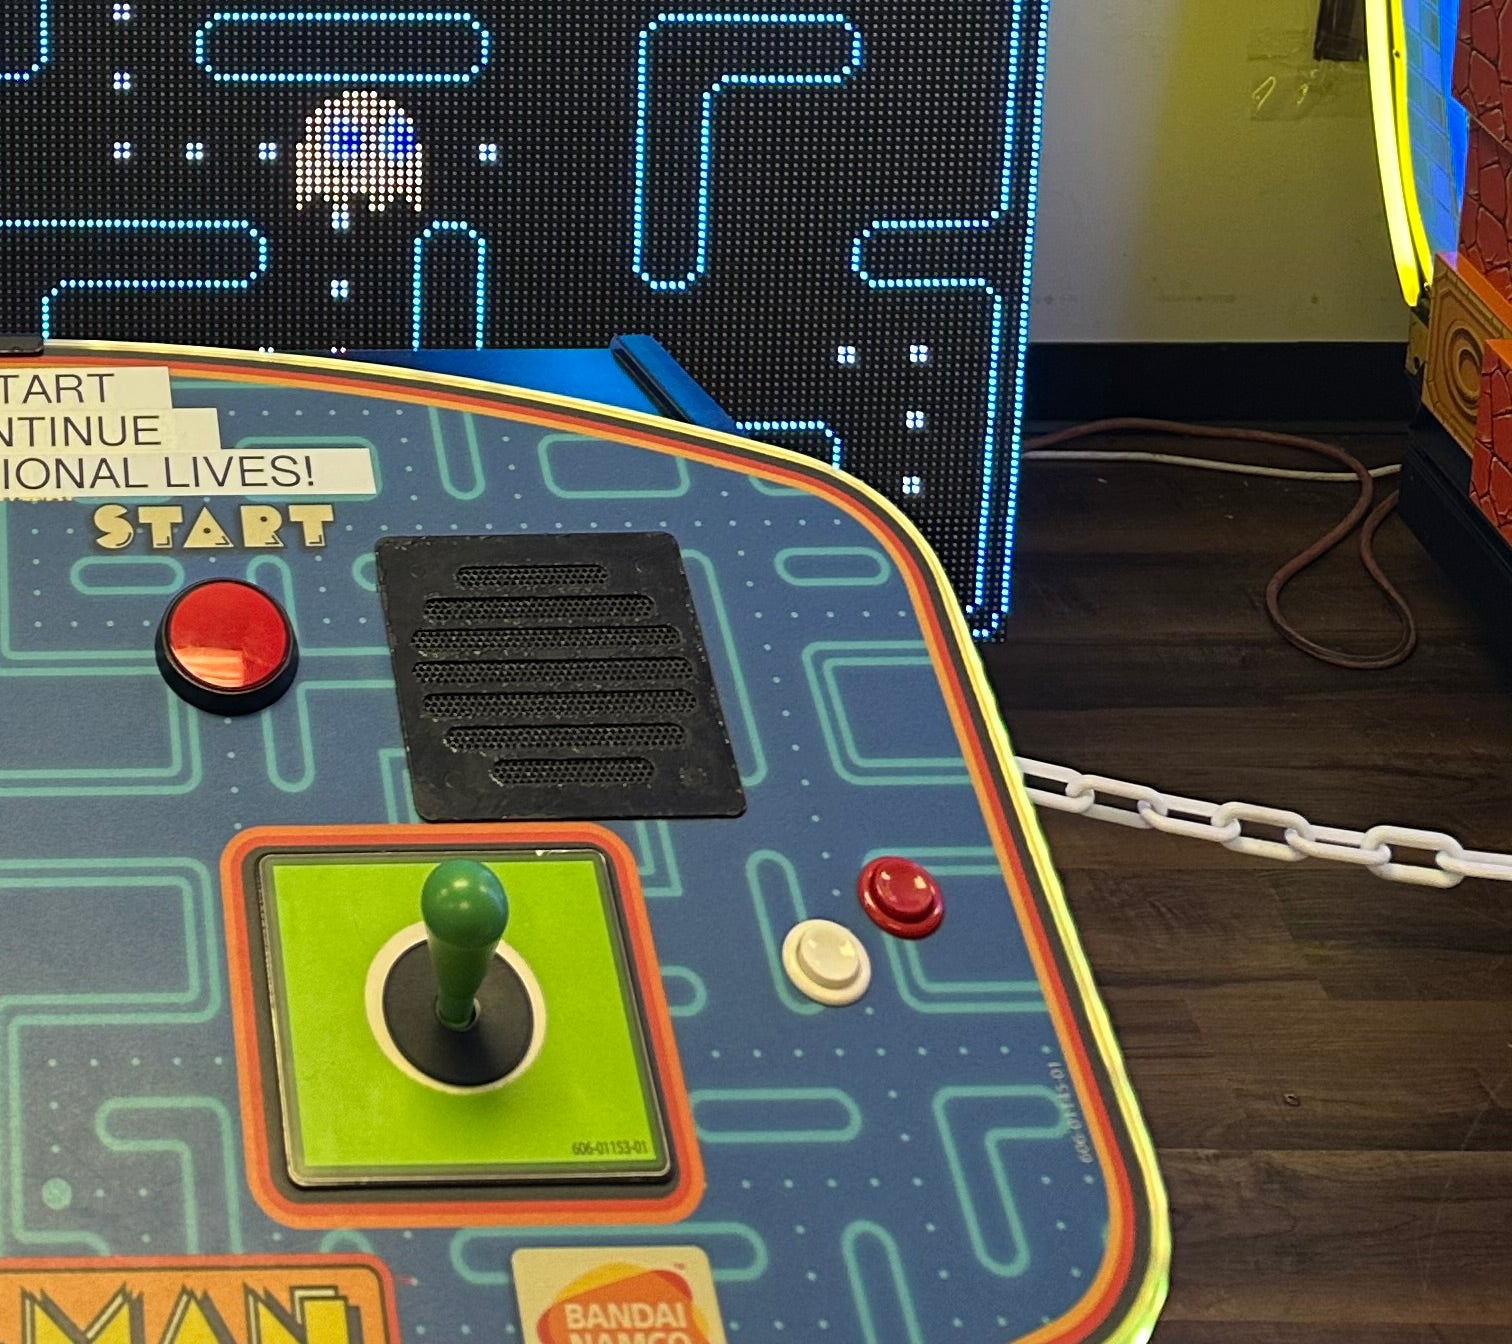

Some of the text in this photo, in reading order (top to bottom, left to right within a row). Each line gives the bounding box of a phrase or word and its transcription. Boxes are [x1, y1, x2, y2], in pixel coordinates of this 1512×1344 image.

[163, 455, 315, 488] LIVES!
[92, 502, 335, 550] START
[563, 1302, 689, 1330] BANDAI
